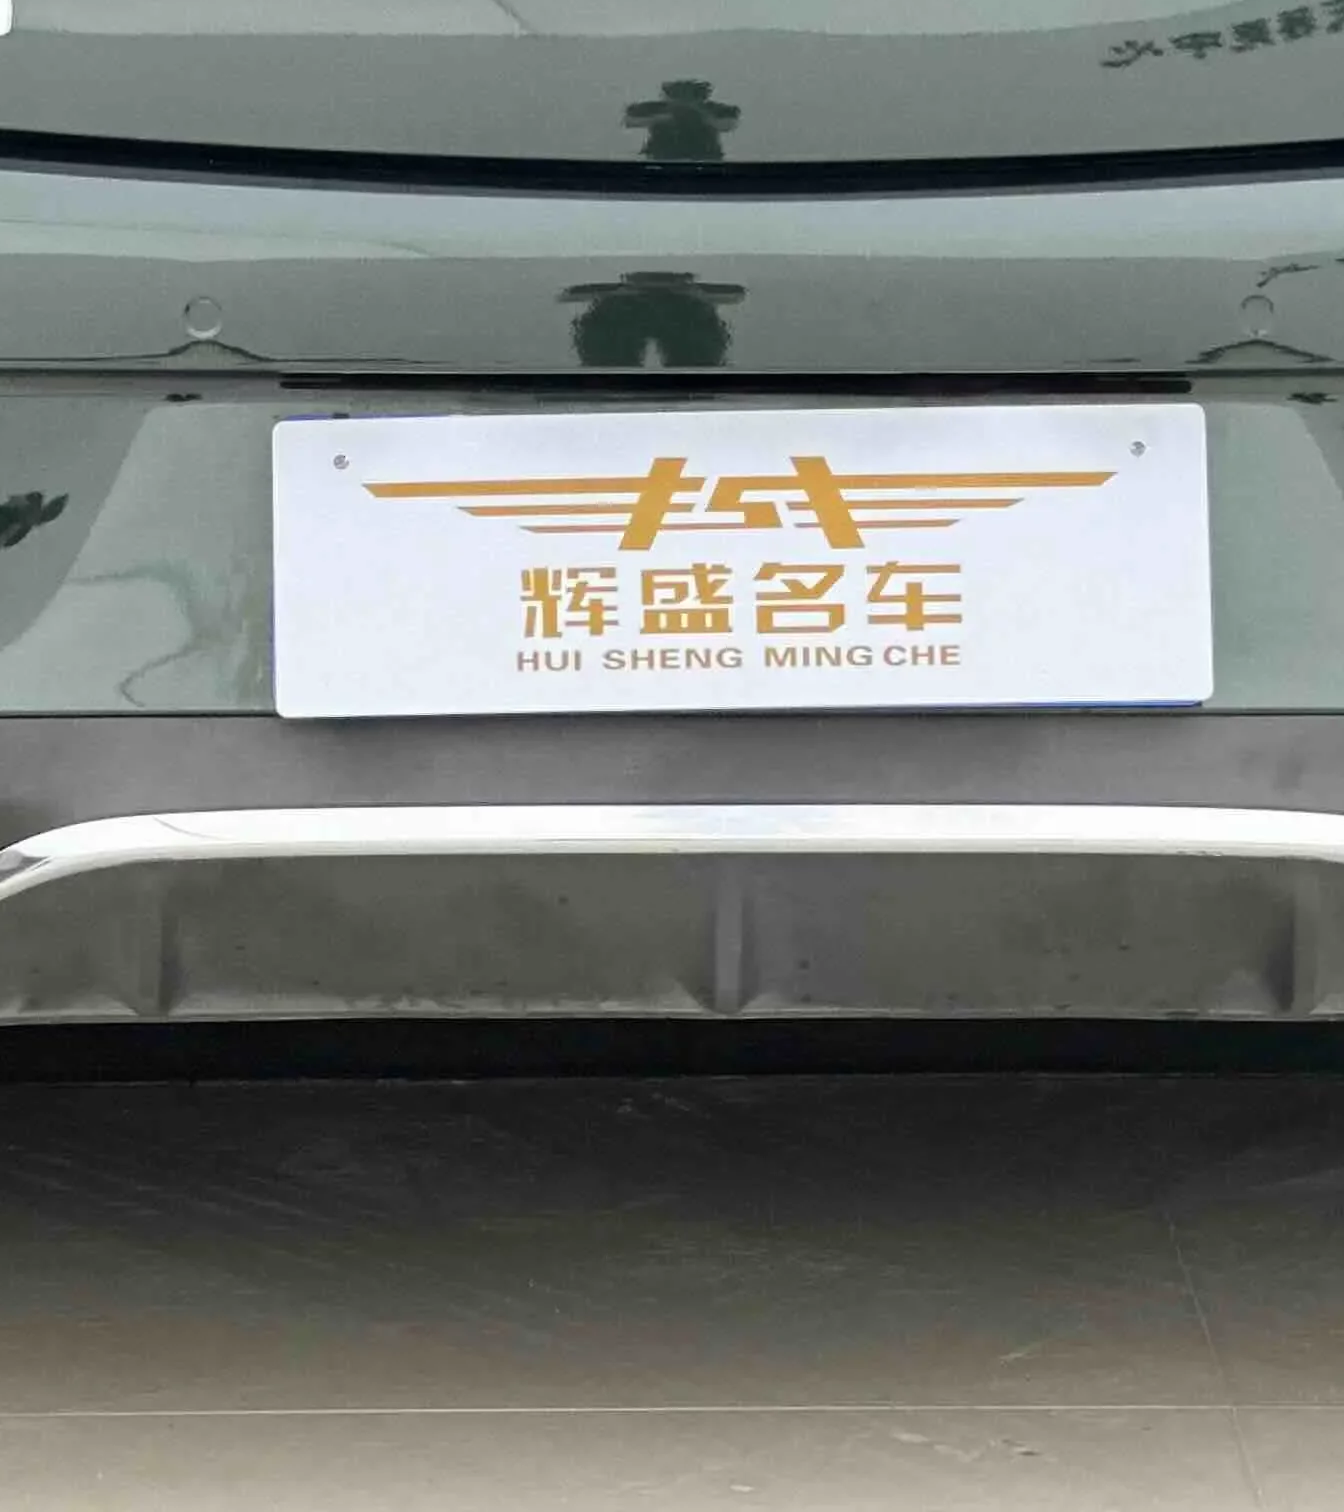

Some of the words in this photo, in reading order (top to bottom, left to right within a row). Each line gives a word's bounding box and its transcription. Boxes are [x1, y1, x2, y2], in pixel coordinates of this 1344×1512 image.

[520, 560, 963, 640] 辉盛名车
[517, 650, 581, 671] HUI
[603, 647, 742, 670] SHENG
[764, 645, 873, 667] MING
[883, 644, 960, 666] CHE
